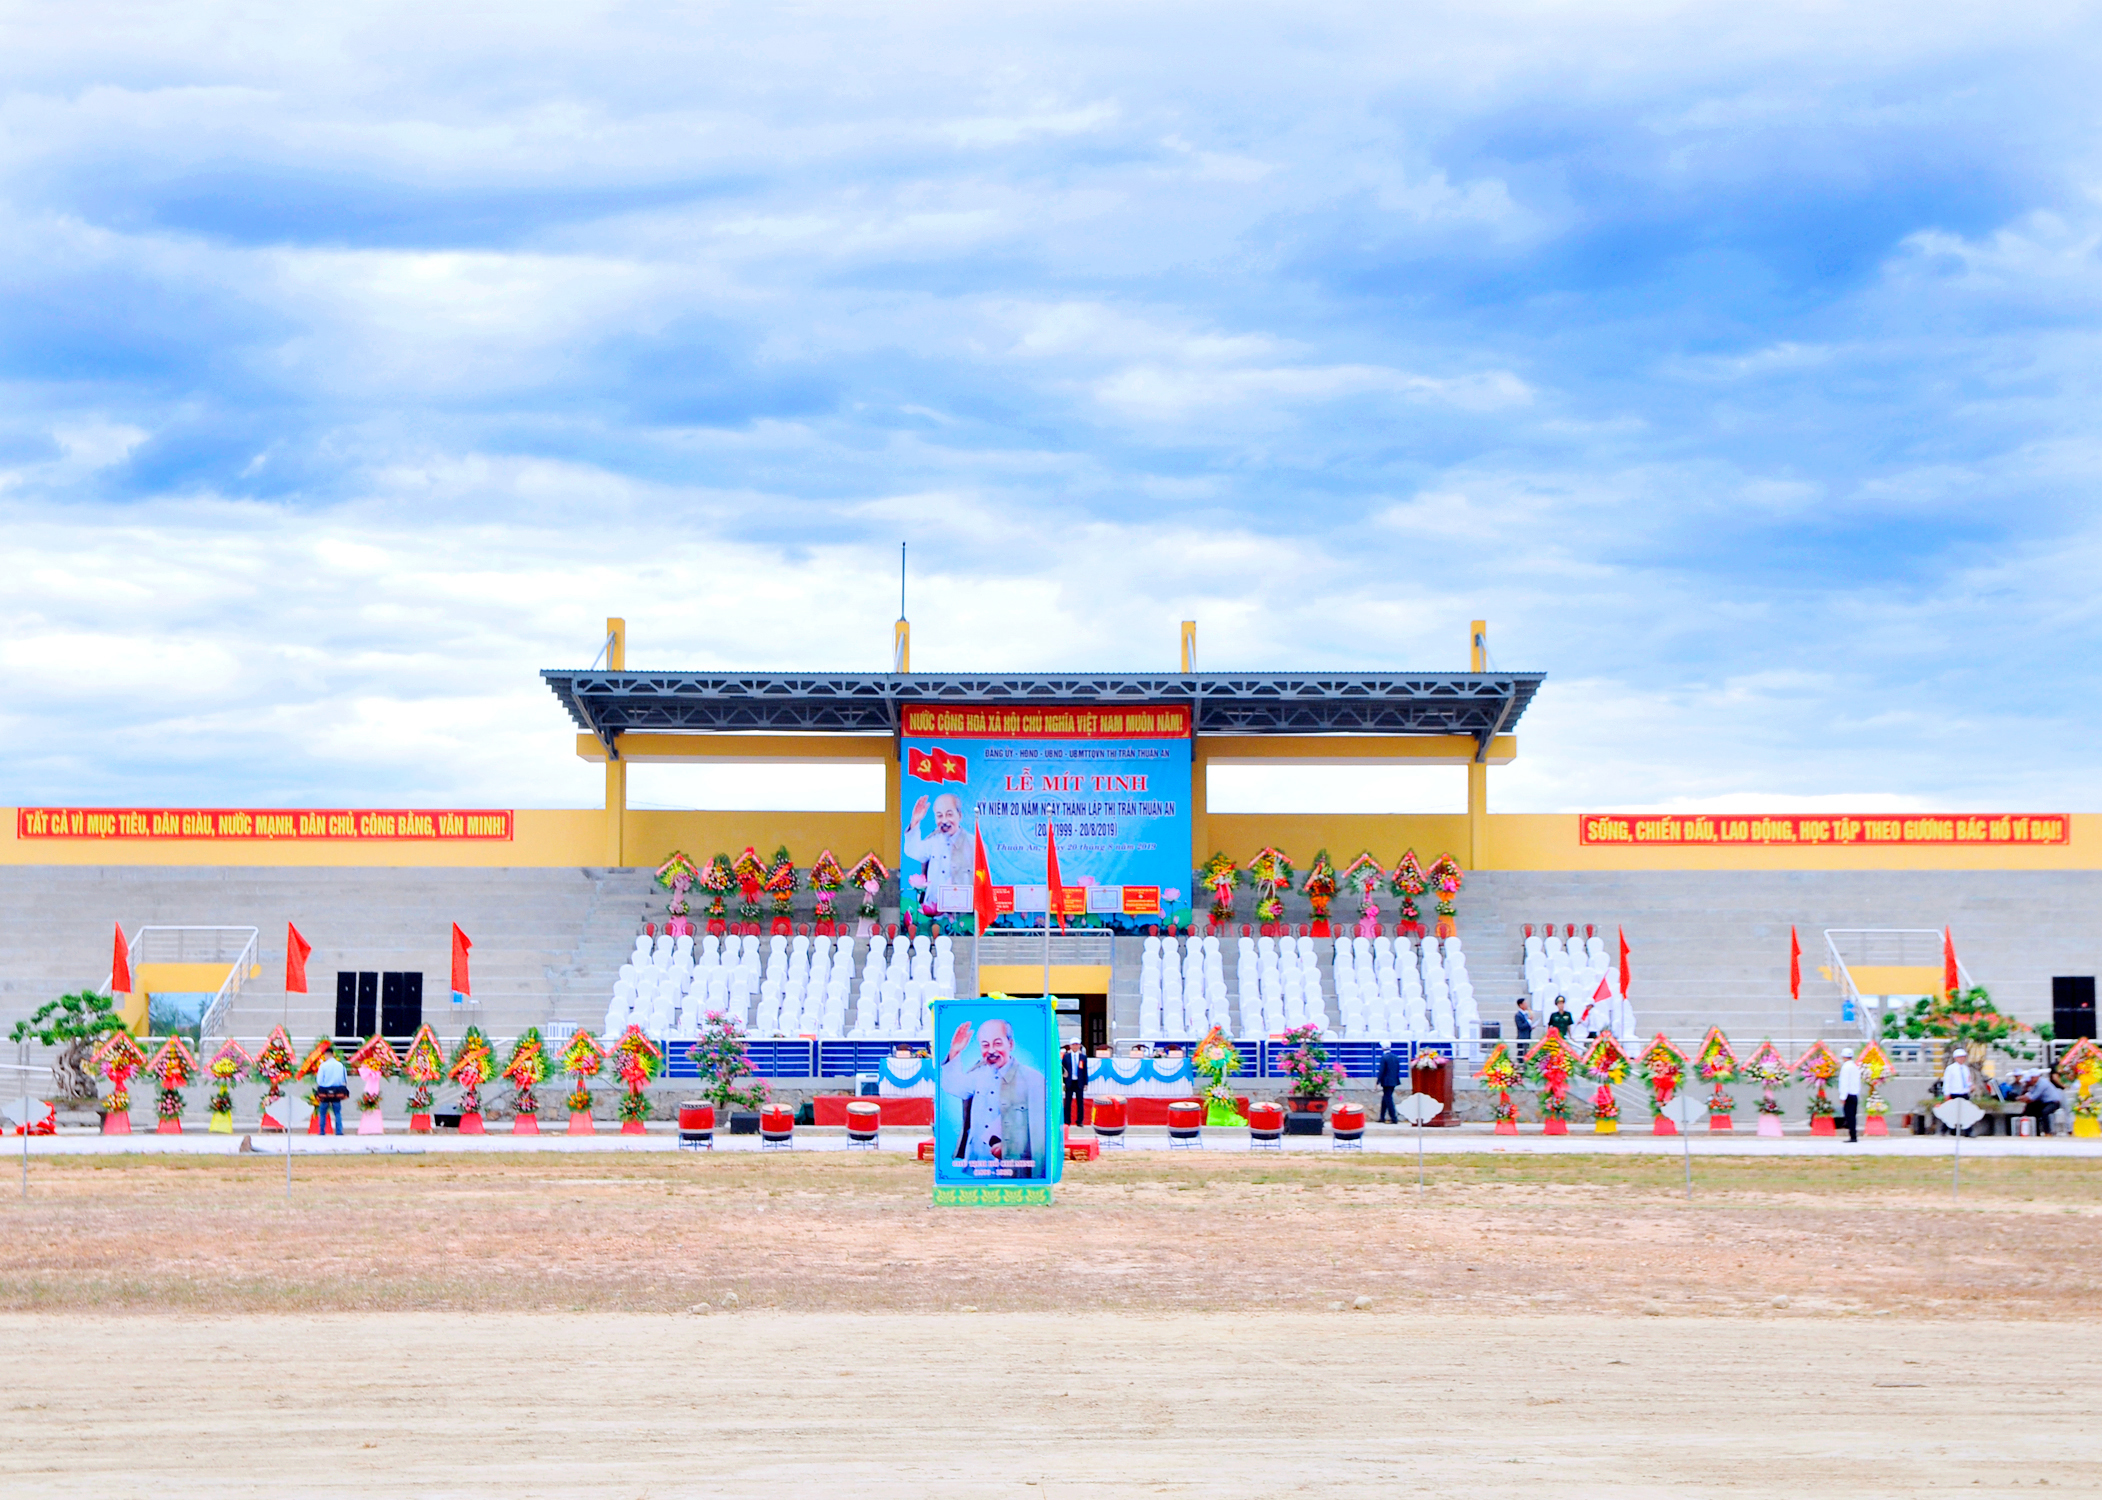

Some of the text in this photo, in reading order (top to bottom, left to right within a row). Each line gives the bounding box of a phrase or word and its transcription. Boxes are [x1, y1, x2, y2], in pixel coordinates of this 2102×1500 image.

[909, 710, 935, 731] NƯỚC
[937, 710, 964, 736] CỘNG
[988, 711, 1002, 732] XÃ
[1003, 711, 1020, 736] HỘI
[1022, 710, 1043, 732] CHỦ
[1044, 712, 1075, 732] NGHĨA
[1077, 711, 1098, 736] VIỆT
[1100, 715, 1123, 732] NAM
[1125, 711, 1155, 732] MUÔN
[1160, 749, 1170, 758] AN
[1004, 767, 1149, 792] LỄ MÍT TINH
[988, 799, 1008, 818] NIỆM
[1010, 802, 1020, 816] 20
[1021, 800, 1039, 816] NĂM
[1088, 799, 1102, 819] LẬP
[1104, 802, 1116, 819] THỊ
[1117, 797, 1137, 816] TRẤN
[1138, 798, 1163, 819] THUẬN
[1165, 802, 1175, 816] AN
[26, 809, 506, 839] TẤT CẢ VÌ MỤC TIÊU, DÂN GIÀU, NƯỚC MẠNH, DÂN CHỦ, CÔNG BẰNG, VĂN MINH!
[1035, 823, 1073, 837] (20/1999
[1079, 823, 1118, 837] 20/8/2019)
[1587, 816, 1633, 842] SỐNG,
[1635, 815, 1681, 840] CHIẾN
[1684, 815, 1718, 842] ĐẤU,
[1721, 820, 1749, 840] LAO
[1750, 817, 1797, 844] ĐỘNG,
[1800, 820, 1830, 844] HỌC
[1831, 817, 1861, 844] TẬP
[1863, 820, 1901, 840] THEO
[1956, 816, 1987, 840] BÁC
